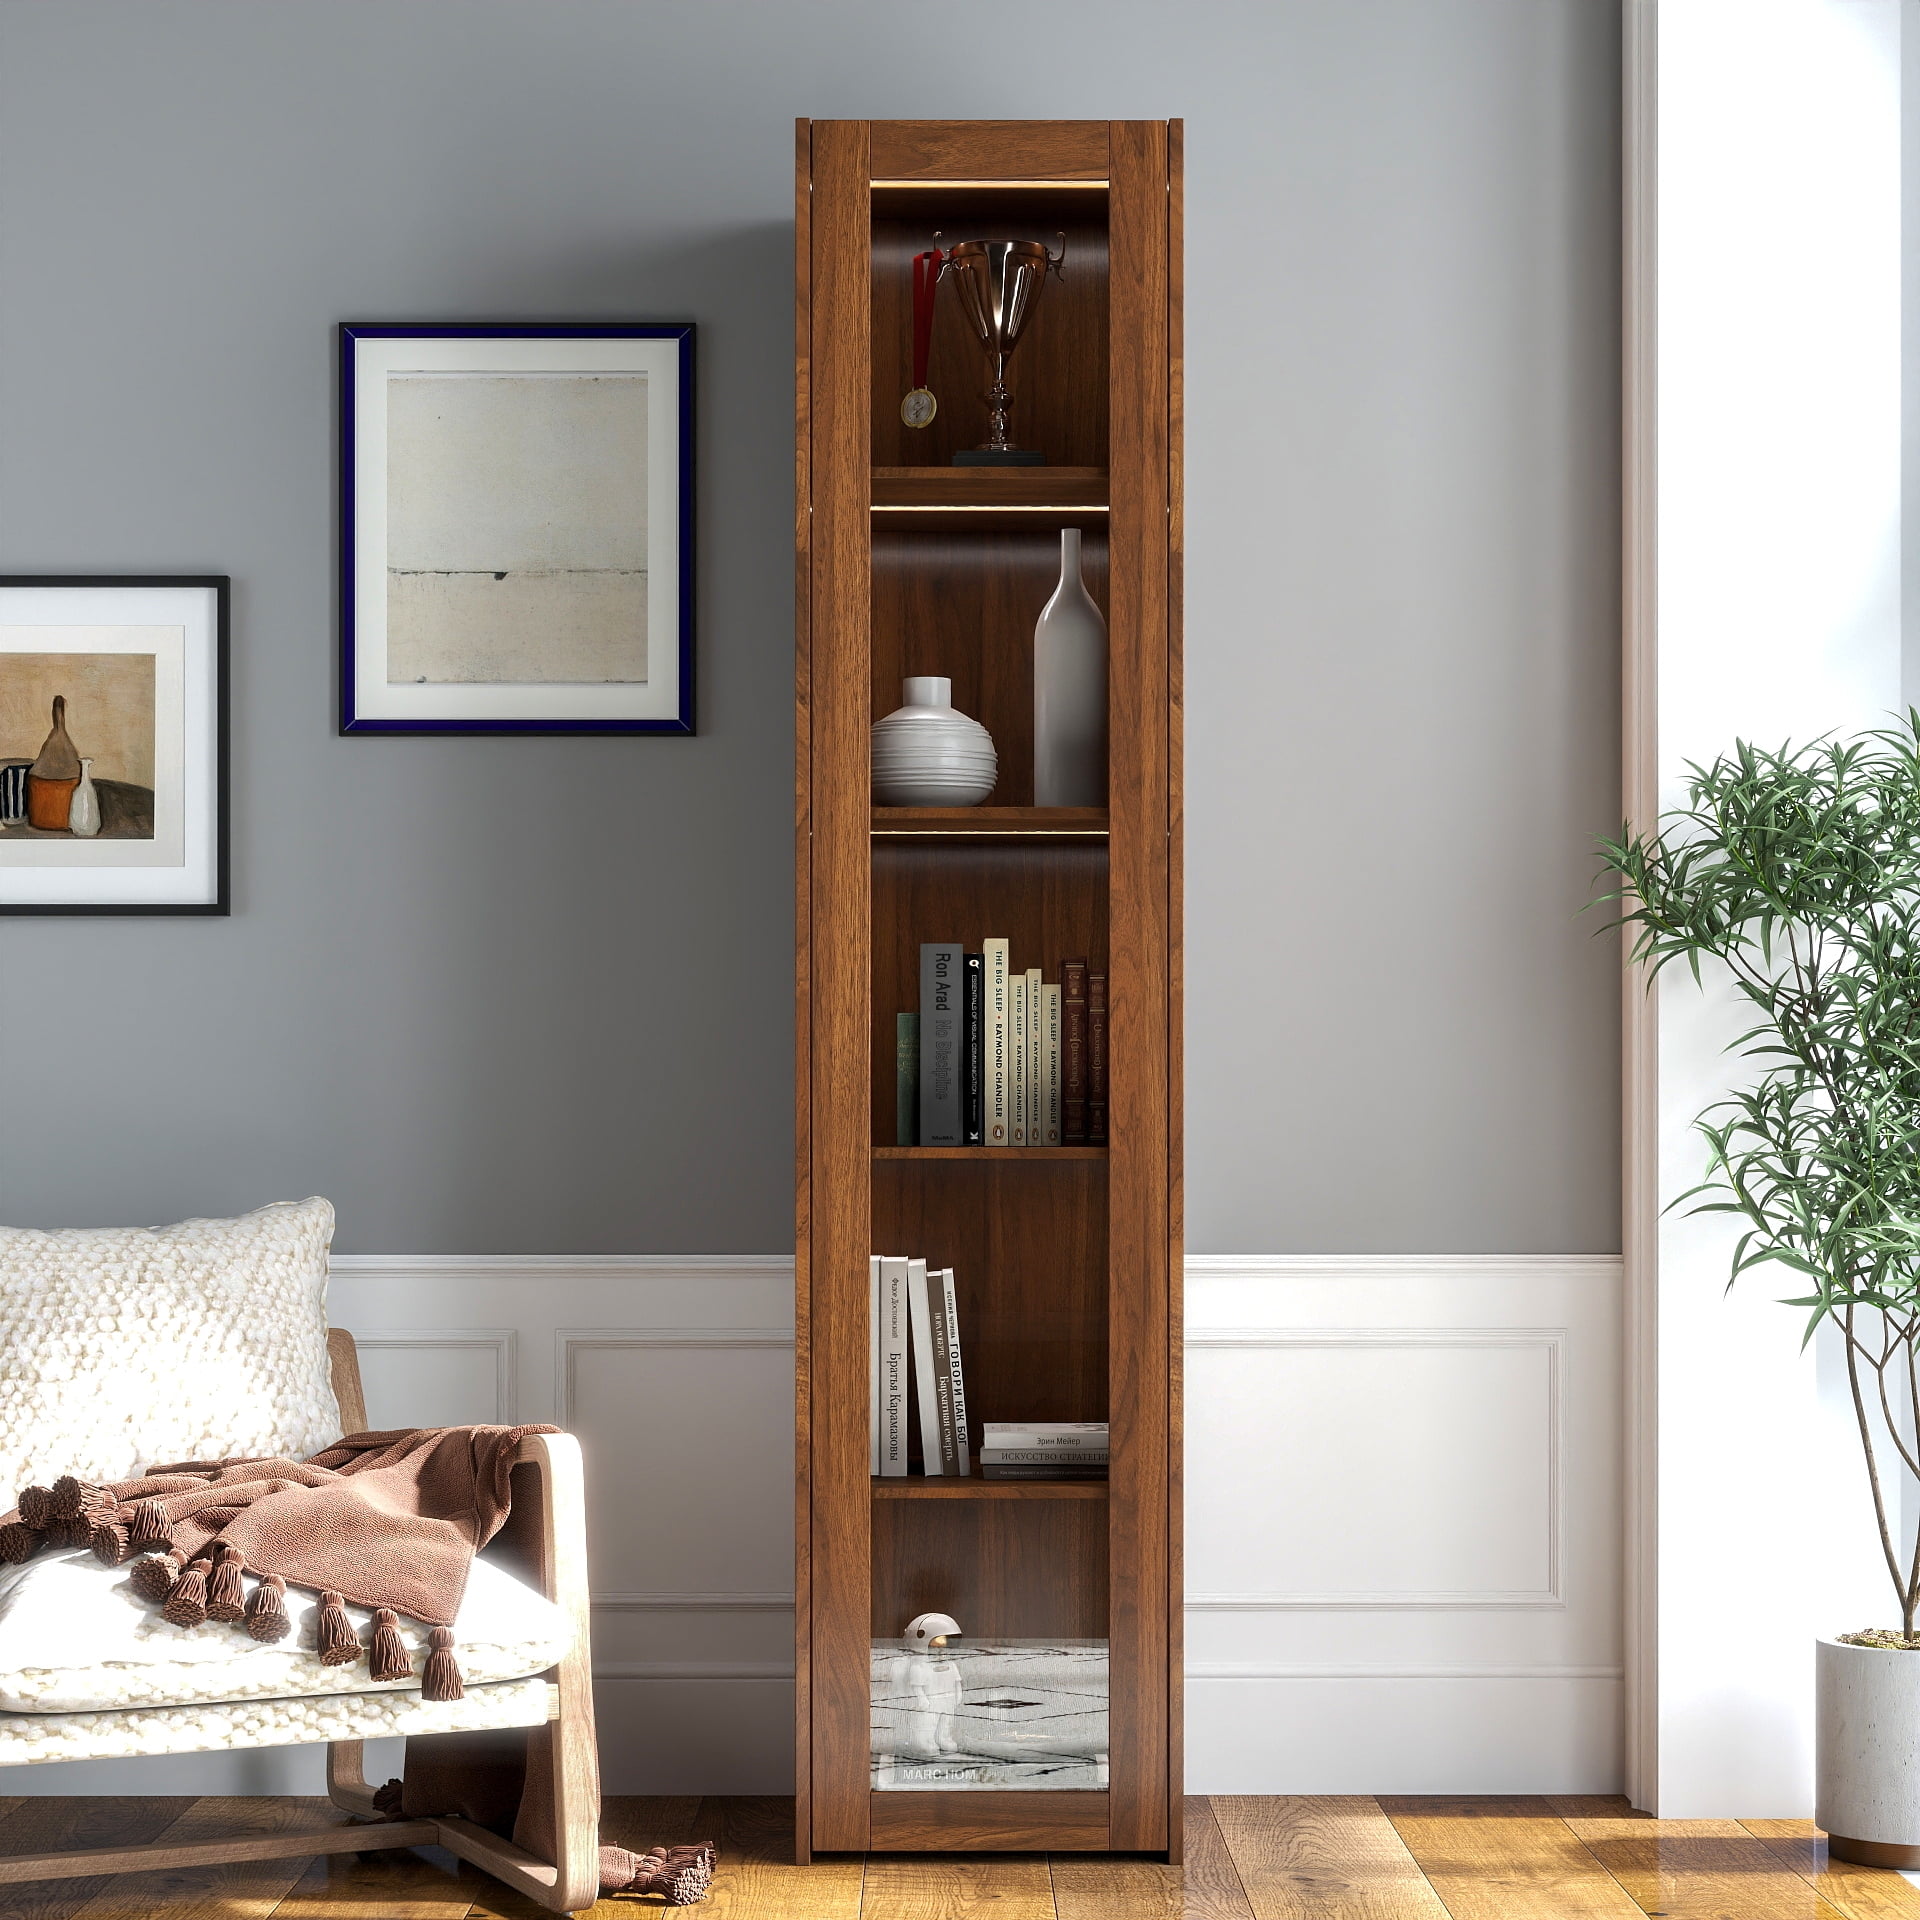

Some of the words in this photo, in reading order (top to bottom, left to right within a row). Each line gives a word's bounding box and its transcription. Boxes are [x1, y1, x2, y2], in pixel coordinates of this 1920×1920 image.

[935, 953, 951, 978] Ron
[995, 951, 1003, 966] THE
[995, 970, 1003, 984] BIG
[935, 982, 951, 1011] Arad
[995, 988, 1003, 1012] SLEEP
[971, 1011, 978, 1020] OF
[935, 1019, 951, 1038] No
[995, 1023, 1003, 1068] RAYMOND
[995, 1072, 1003, 1118] CHANDLER
[886, 1353, 901, 1391] Братья
[949, 1343, 962, 1396] ГОВОРИ
[938, 1375, 950, 1426] Бархатная
[954, 1400, 965, 1421] КАК
[886, 1394, 901, 1461] Карамазовы
[957, 1426, 967, 1446] БОГ
[943, 1428, 953, 1461] смерть
[1036, 1437, 1055, 1446] Эрин
[1056, 1436, 1081, 1446] Мейер
[1001, 1452, 1057, 1462] ИСКУССТВО
[1059, 1452, 1108, 1462] СТРАТЕГИ
[903, 1769, 942, 1780] MARC
